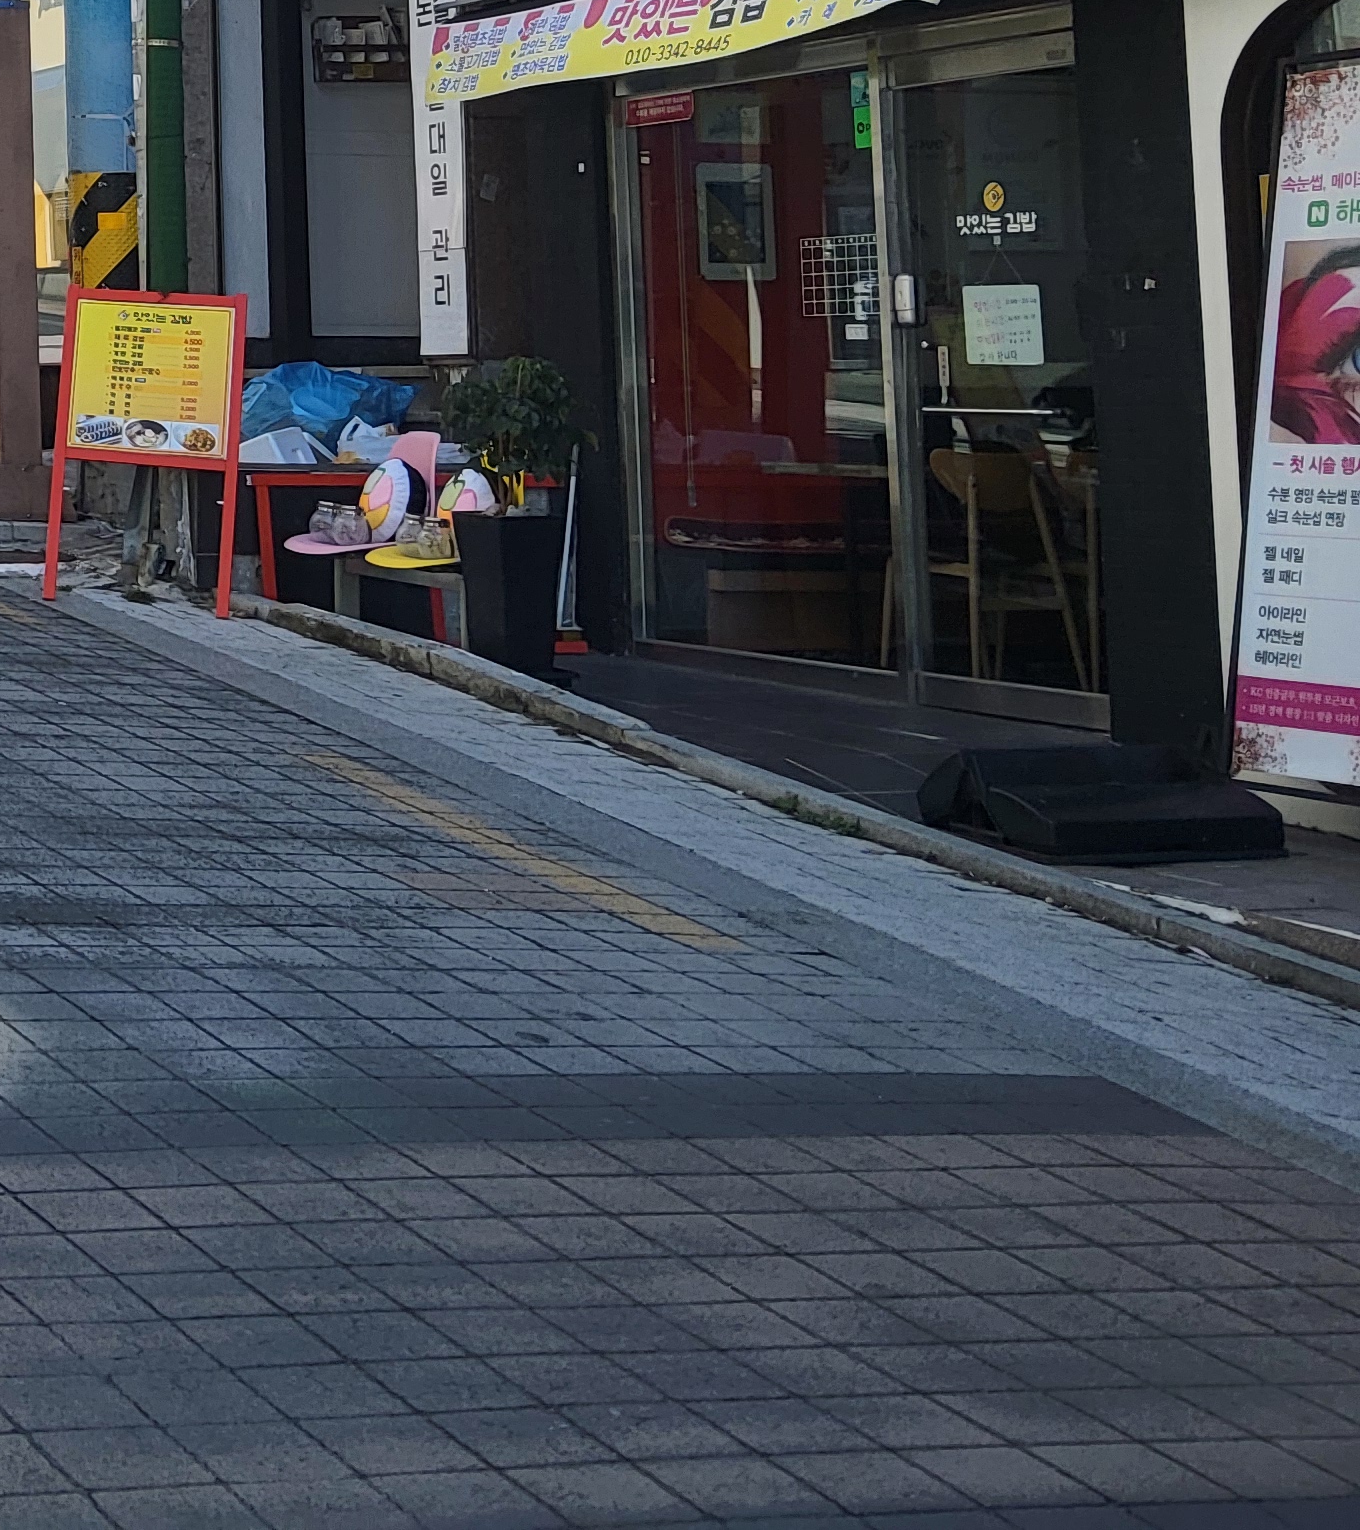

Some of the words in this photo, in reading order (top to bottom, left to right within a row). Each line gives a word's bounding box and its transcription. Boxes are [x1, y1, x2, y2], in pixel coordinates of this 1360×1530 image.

[624, 33, 732, 66] 010-3342-8445
[437, 77, 461, 94] 참치
[461, 74, 480, 93] 김밥
[1336, 198, 1360, 224] 하
[956, 214, 1002, 236] 맛있는
[1004, 211, 1038, 233] 김밥
[430, 227, 452, 308] 관리
[133, 311, 167, 324] 맛있는
[169, 314, 193, 325] 김밥
[1308, 455, 1337, 475] 시술
[1267, 486, 1291, 503] 수분
[1266, 509, 1289, 524] 실크
[1325, 511, 1346, 528] 연장
[1280, 547, 1305, 563] 네일
[1278, 569, 1302, 586] 패디
[1258, 605, 1307, 624] 아이라인
[1256, 627, 1305, 647] 자연눈썹
[1254, 650, 1302, 669] 헤어라인
